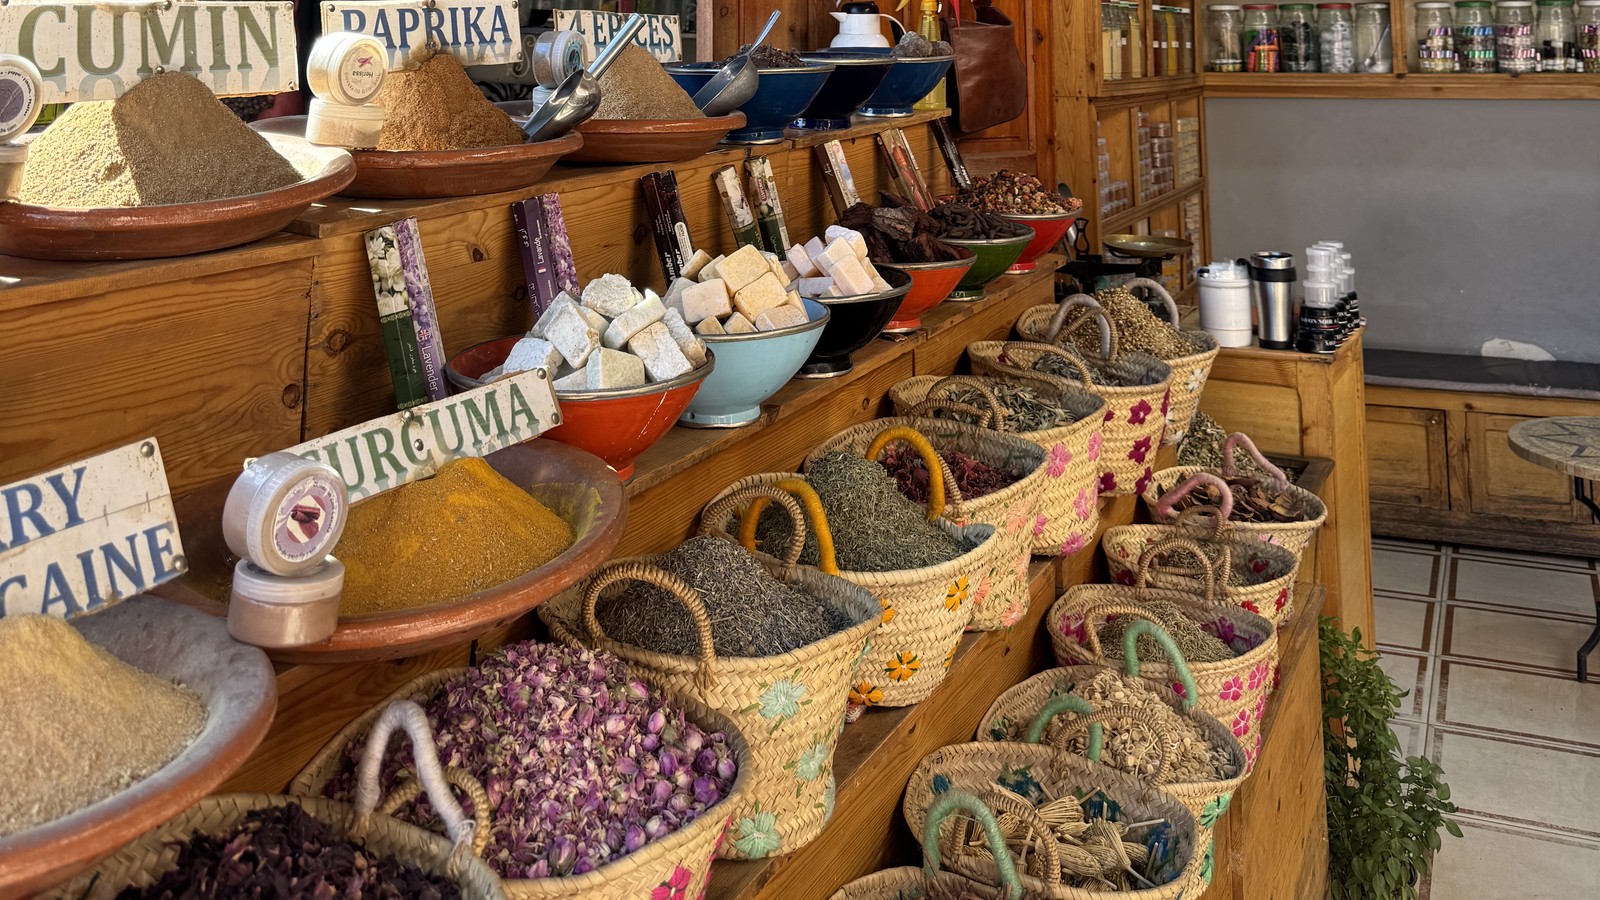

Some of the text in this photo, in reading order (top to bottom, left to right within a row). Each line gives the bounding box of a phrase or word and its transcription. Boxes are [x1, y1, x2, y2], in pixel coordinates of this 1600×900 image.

[18, 5, 279, 77] CUMIN
[341, 5, 512, 49] PAPRIKA
[592, 11, 674, 47] EPCES
[533, 237, 545, 265] Lavande
[421, 345, 439, 391] Lavender
[0, 466, 87, 551] RY
